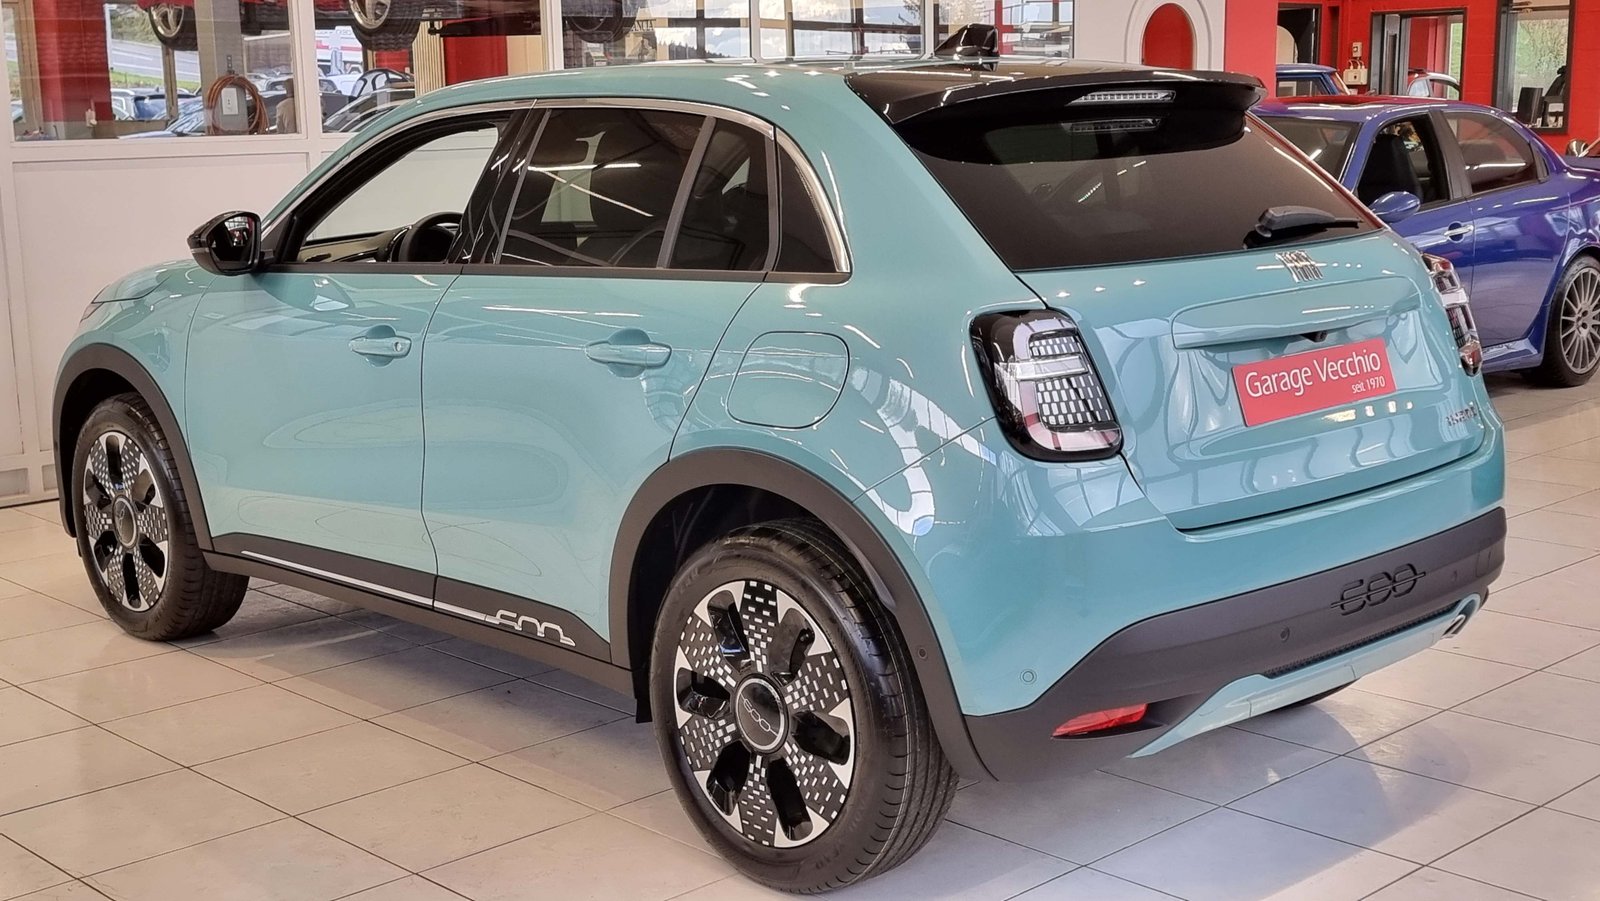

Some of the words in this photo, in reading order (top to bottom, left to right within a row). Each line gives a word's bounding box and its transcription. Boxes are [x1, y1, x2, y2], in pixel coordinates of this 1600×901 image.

[1245, 367, 1313, 397] Garage
[1313, 349, 1381, 382] Vecchio
[1351, 381, 1366, 394] seit
[1366, 376, 1386, 390] 1970
[1338, 563, 1419, 616] 600
